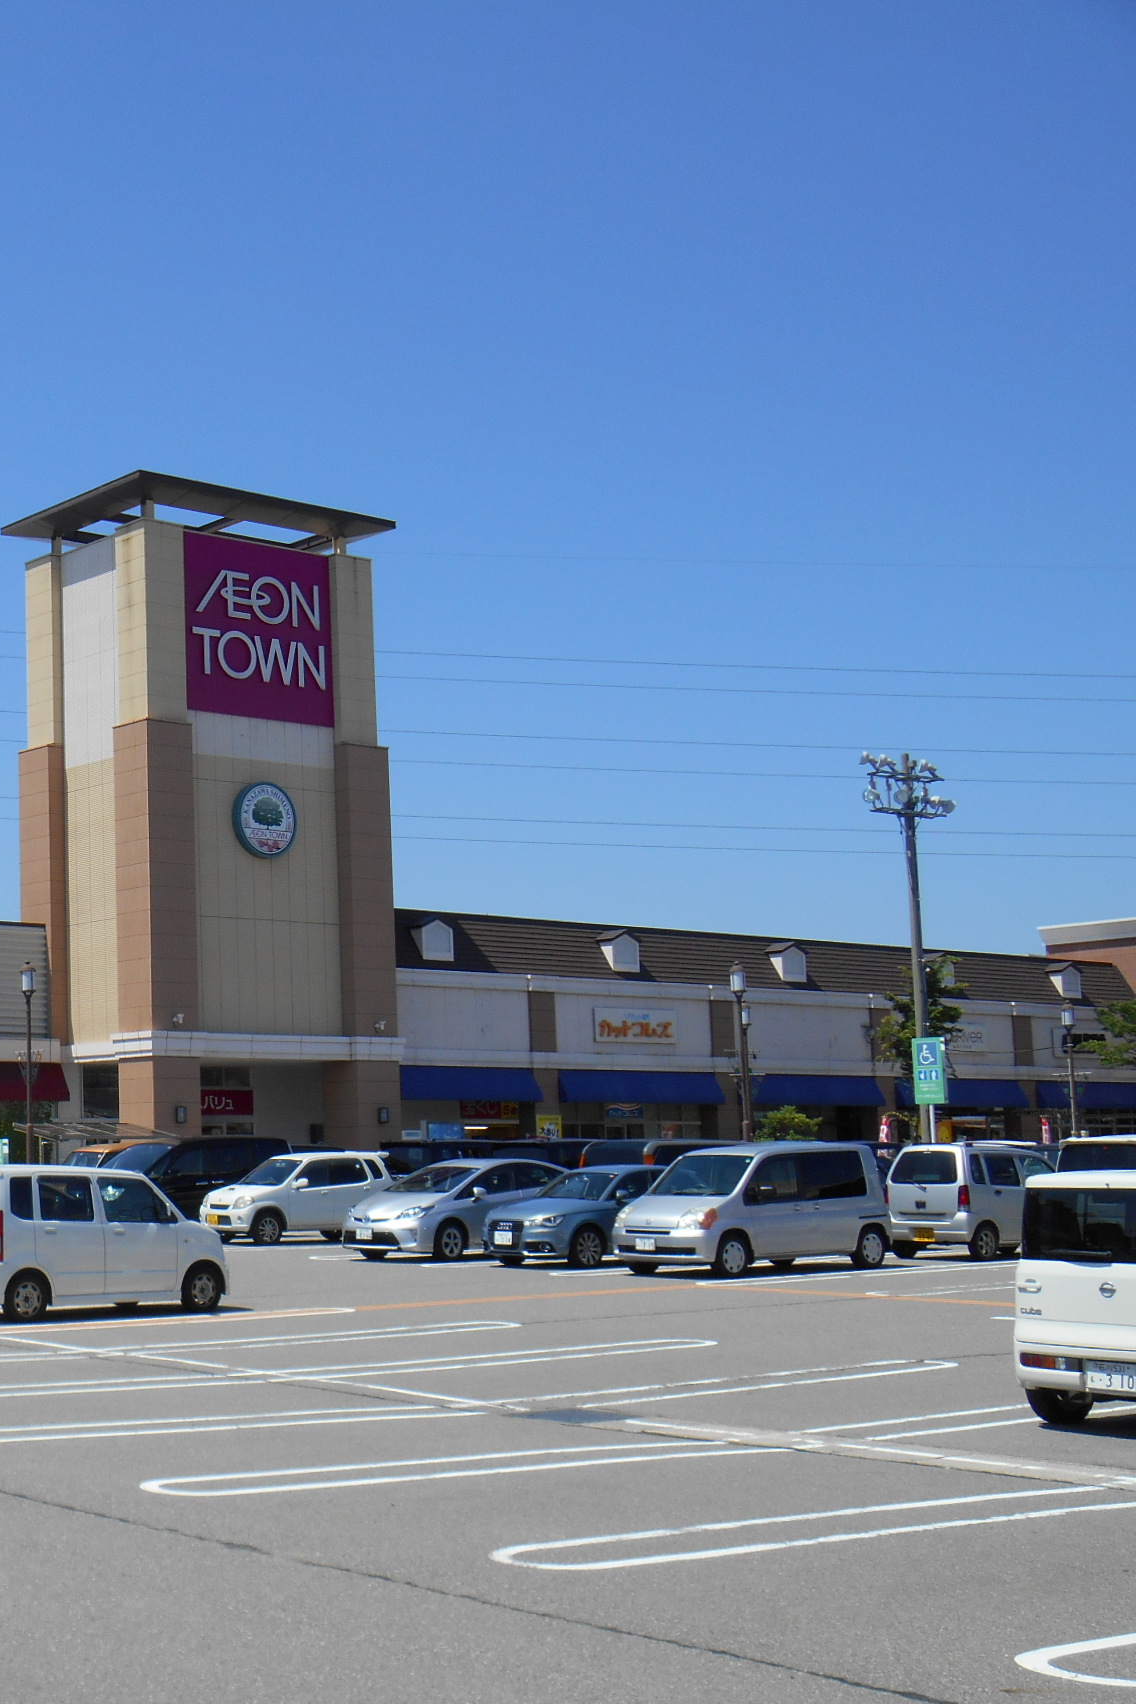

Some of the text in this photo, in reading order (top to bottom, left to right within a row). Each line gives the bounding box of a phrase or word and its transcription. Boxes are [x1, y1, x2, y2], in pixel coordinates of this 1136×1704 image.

[192, 626, 326, 690] TOWN
[244, 788, 292, 820] KANAZAWA SHIMENO
[269, 831, 288, 840] TOWN
[201, 1095, 235, 1110] バリュ
